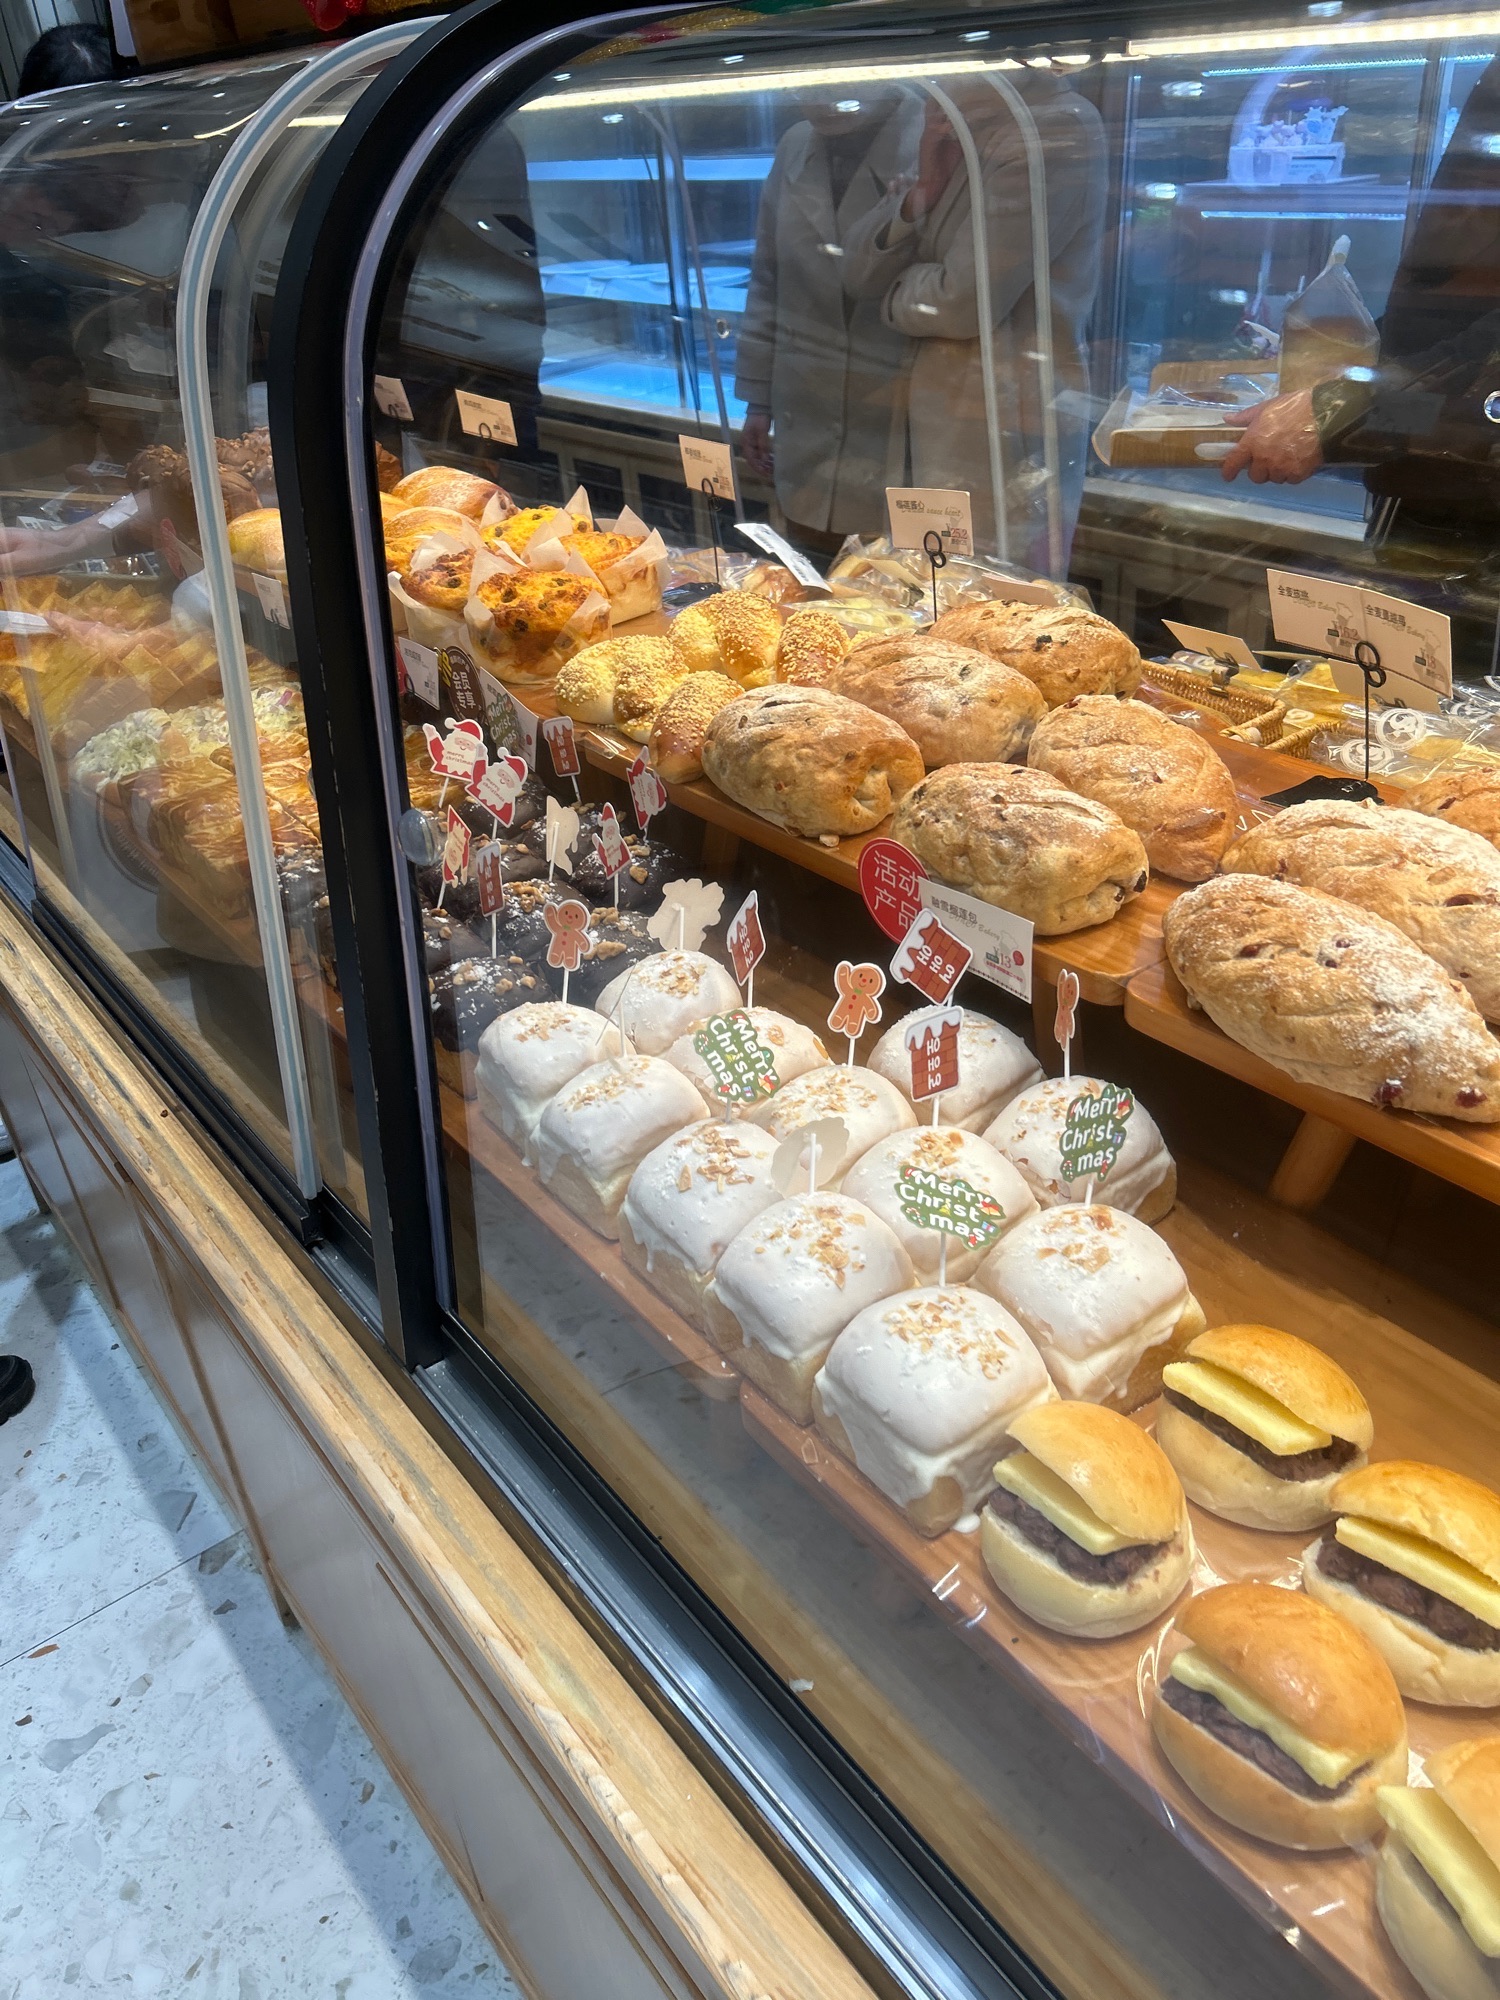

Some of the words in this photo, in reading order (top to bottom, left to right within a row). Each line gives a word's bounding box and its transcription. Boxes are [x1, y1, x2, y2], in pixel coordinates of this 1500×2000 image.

[452, 671, 472, 690] 会员
[456, 690, 476, 709] 专享
[490, 714, 512, 740] Christ
[502, 729, 517, 749] mas
[873, 850, 920, 902] 活动
[873, 885, 917, 930] 产品
[710, 1018, 755, 1084] Christ
[733, 1019, 777, 1080] Merry
[707, 1050, 741, 1096] mas
[1074, 1092, 1127, 1122] Merry
[1062, 1119, 1114, 1151] Christ
[1077, 1146, 1114, 1172] mas
[899, 1184, 980, 1223] Christ
[911, 1170, 992, 1208] Merry
[929, 1213, 986, 1242] mas
